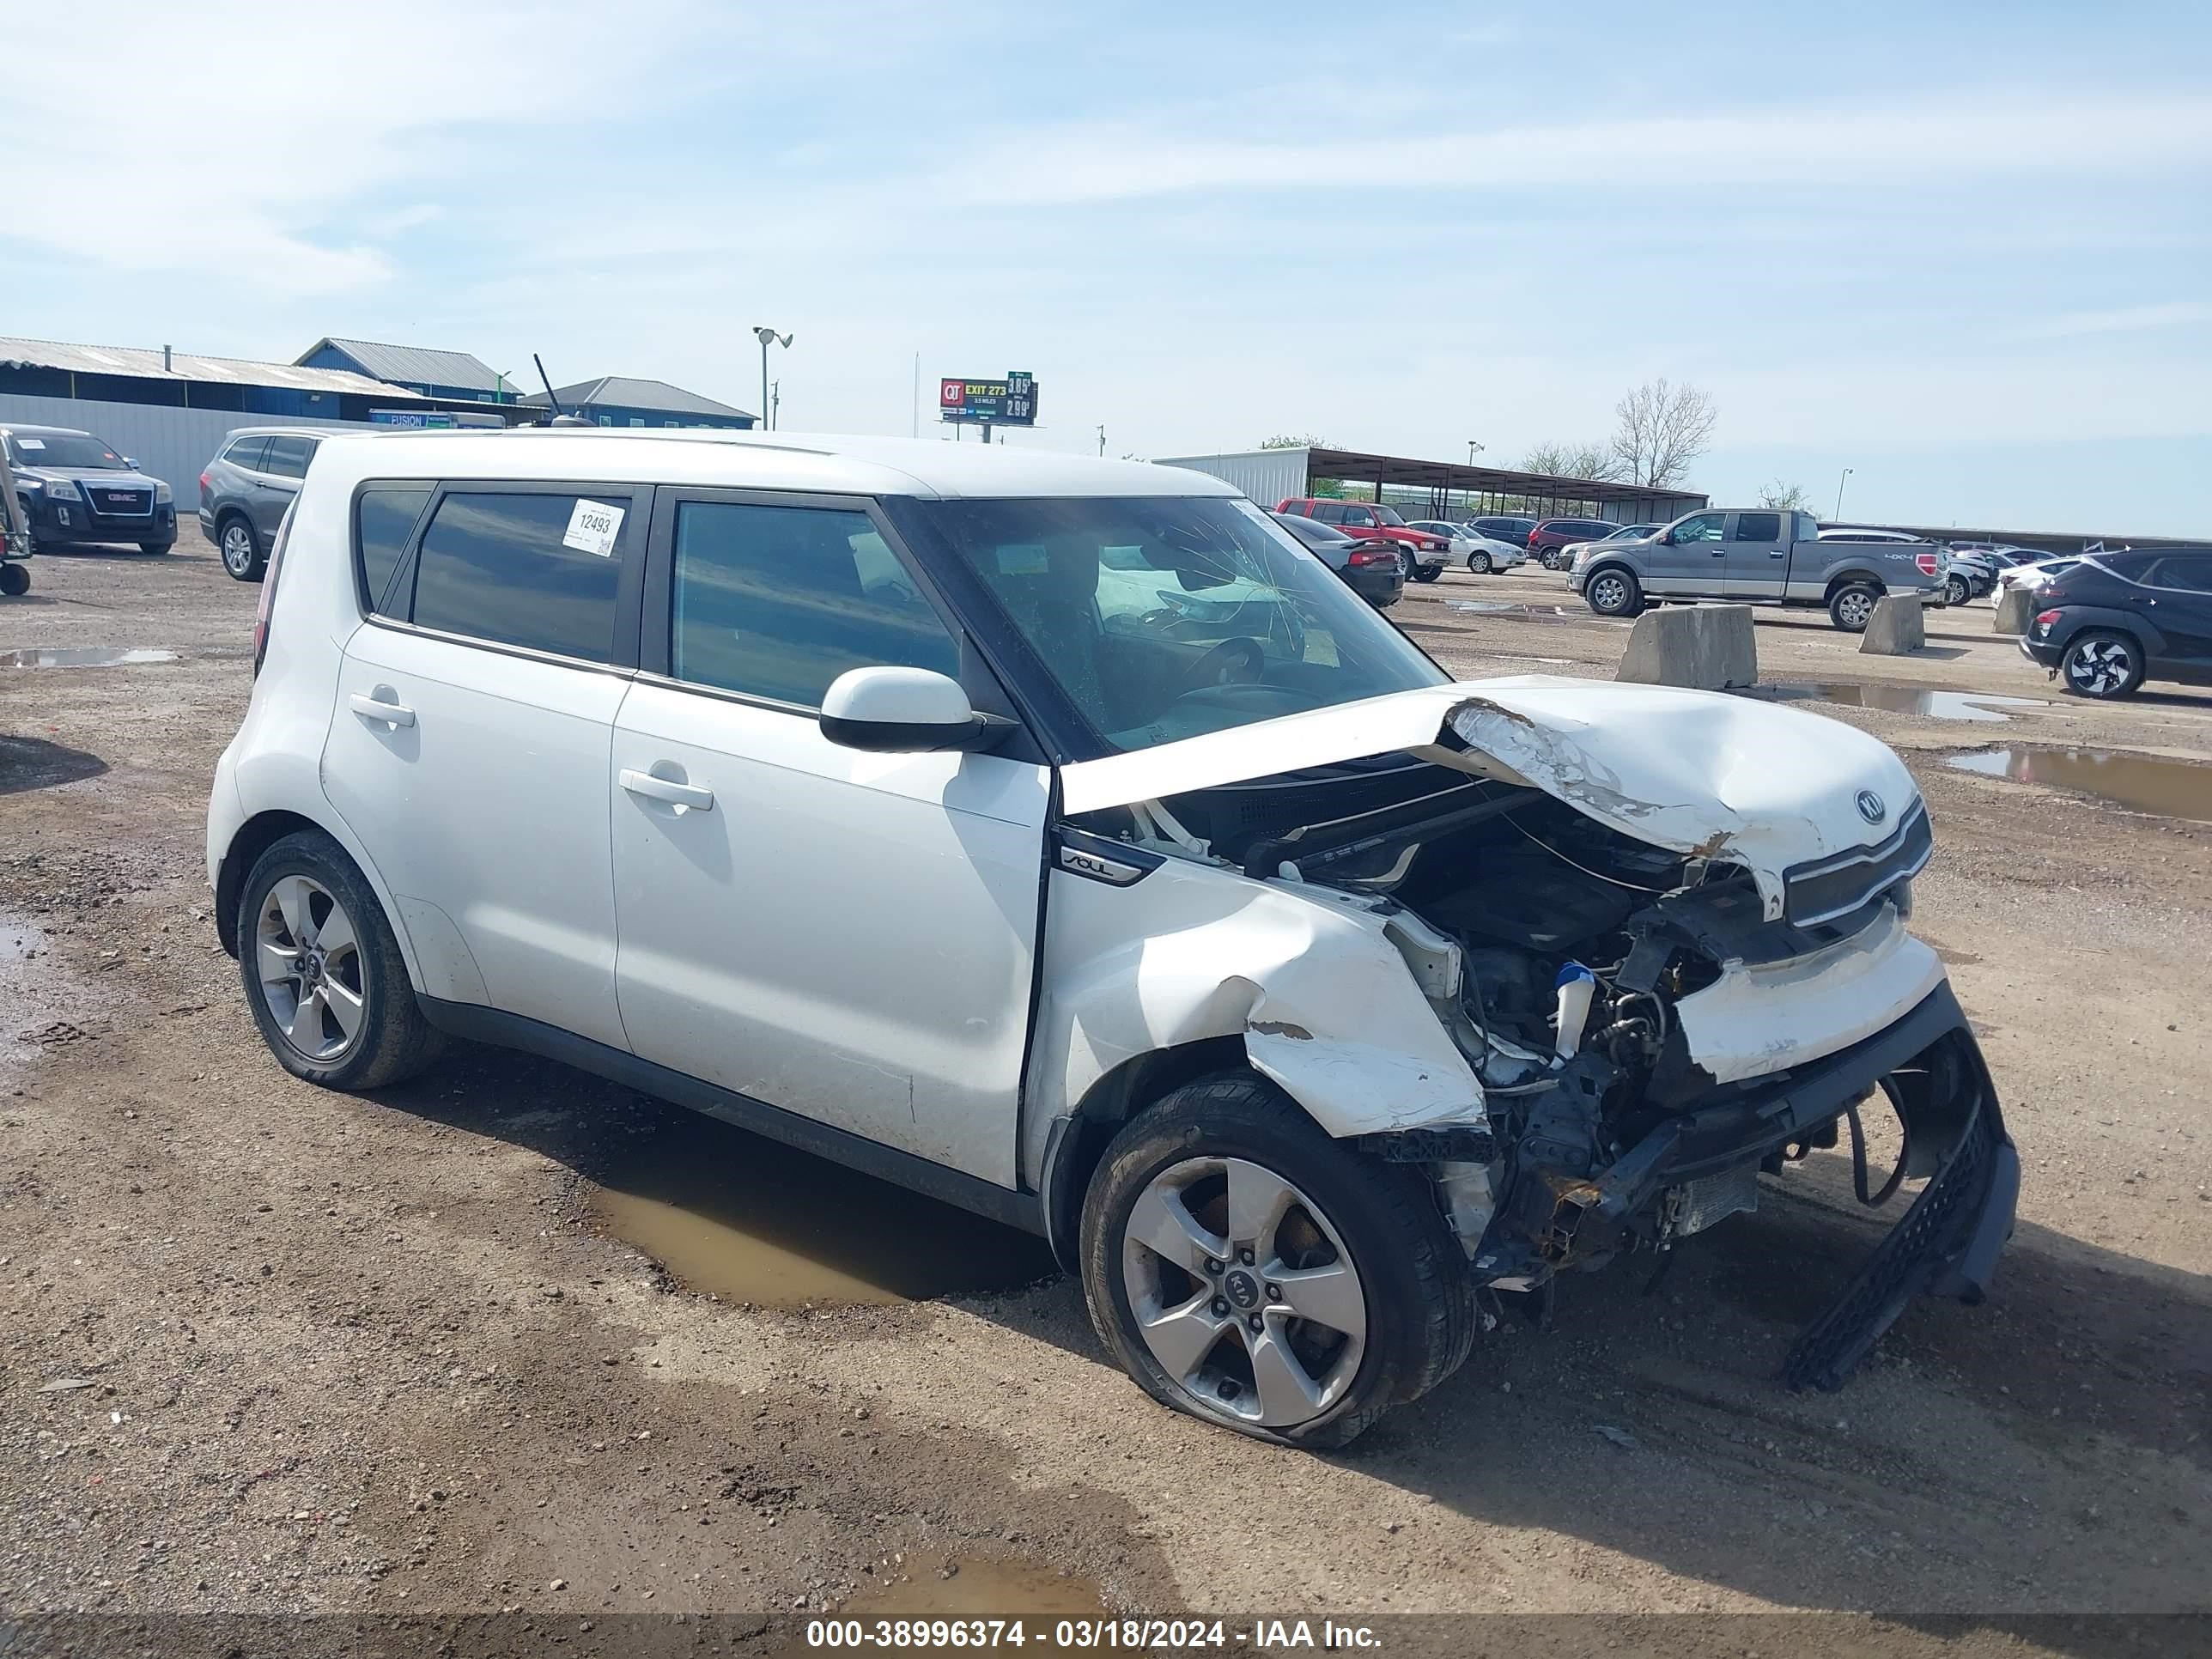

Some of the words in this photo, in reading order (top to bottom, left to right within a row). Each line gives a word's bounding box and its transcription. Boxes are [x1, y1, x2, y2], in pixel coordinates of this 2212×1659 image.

[945, 384, 961, 401] QT
[965, 384, 987, 395] EXIT
[988, 386, 1006, 396] 273
[391, 415, 422, 427] FUSION
[108, 494, 137, 502] GMC
[580, 514, 611, 534] 12493
[1231, 1275, 1250, 1305] KIA
